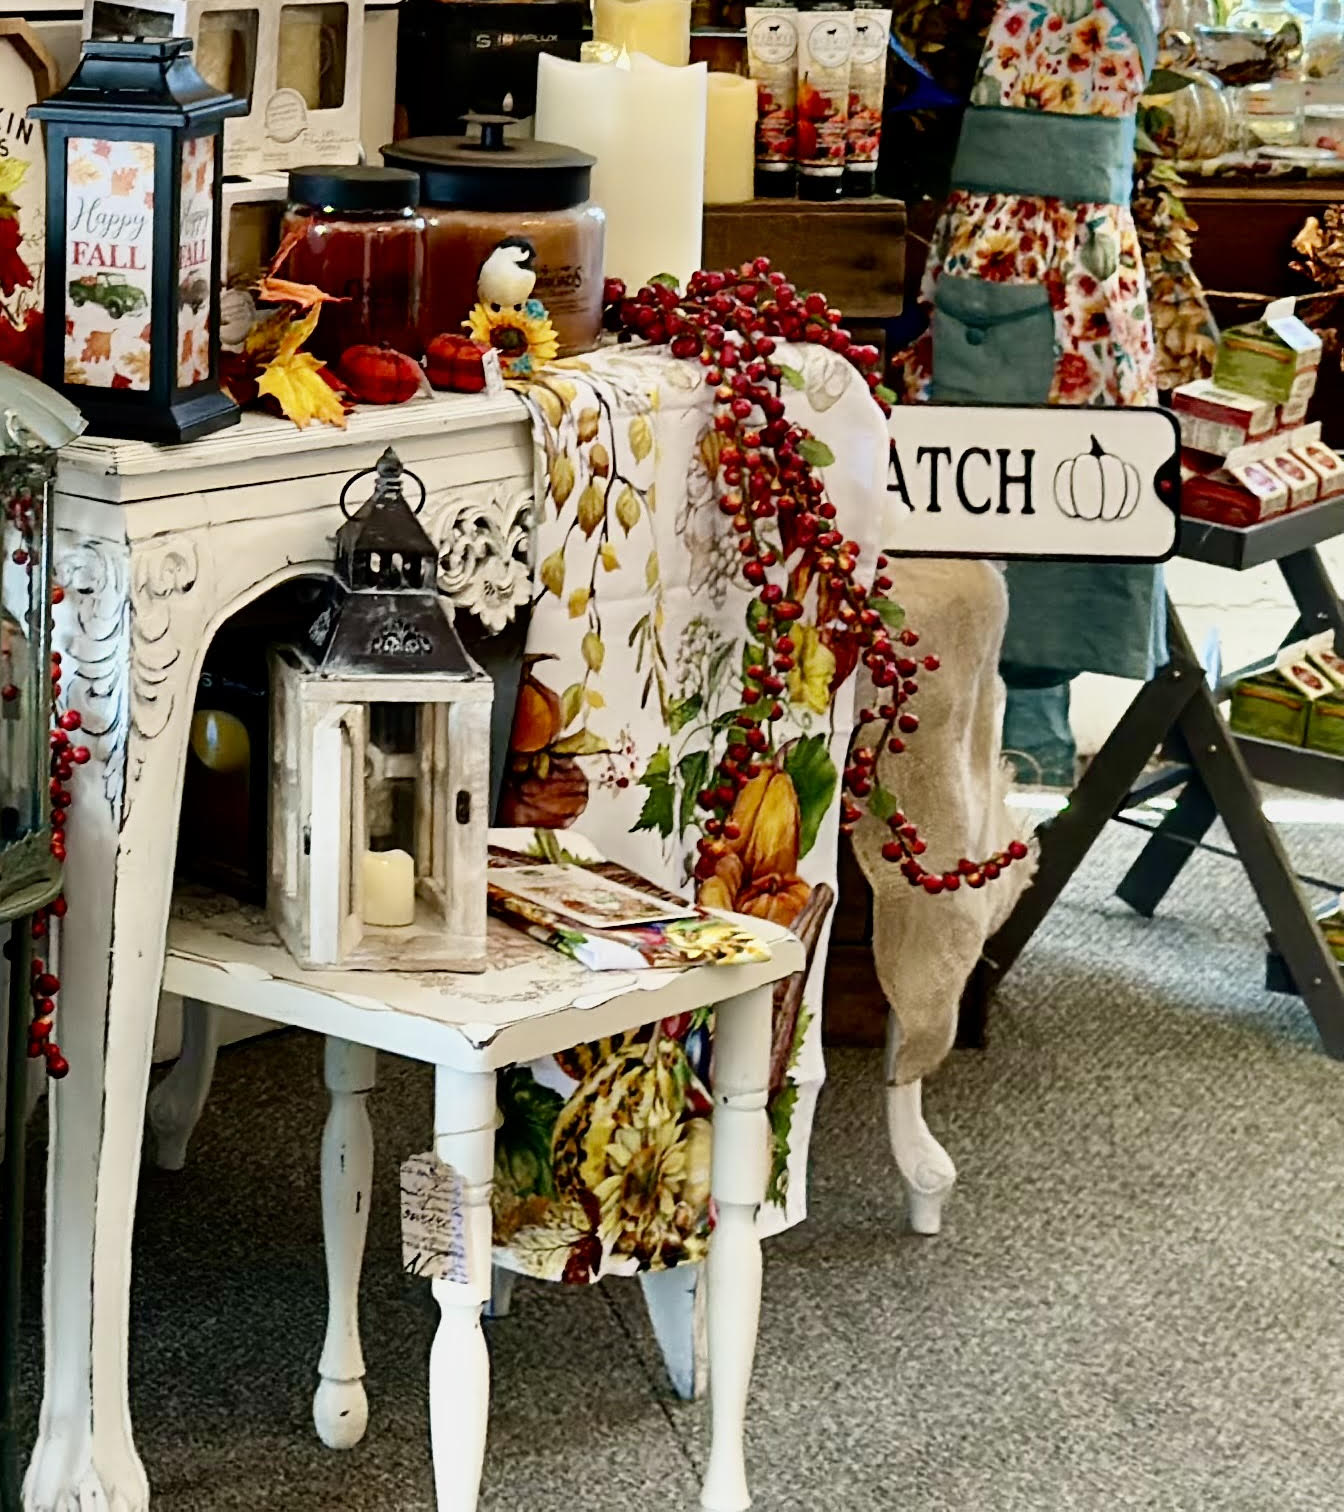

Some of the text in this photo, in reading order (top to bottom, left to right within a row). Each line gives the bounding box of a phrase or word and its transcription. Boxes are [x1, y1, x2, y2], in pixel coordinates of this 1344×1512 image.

[71, 196, 146, 243] Happy
[71, 240, 147, 271] FALL
[887, 440, 1036, 515] ATCH
